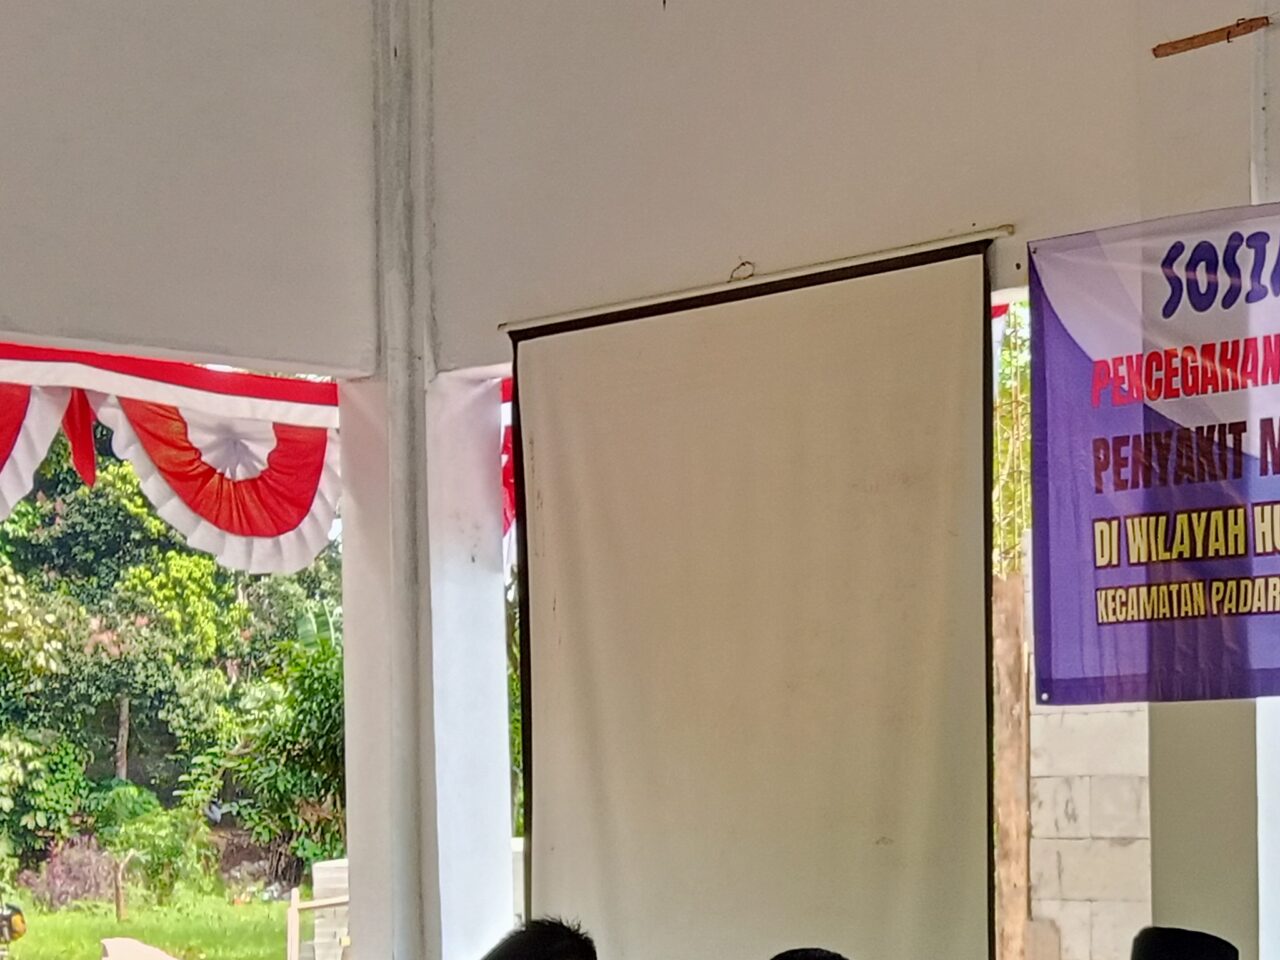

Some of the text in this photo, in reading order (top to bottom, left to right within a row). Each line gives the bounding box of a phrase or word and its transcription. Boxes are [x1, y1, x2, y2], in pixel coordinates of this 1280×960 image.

[1091, 420, 1247, 494] PENYAKIT
[1094, 518, 1120, 568] DI
[1125, 506, 1246, 565] WILAYAH
[1096, 579, 1206, 626] KECAMATAN
